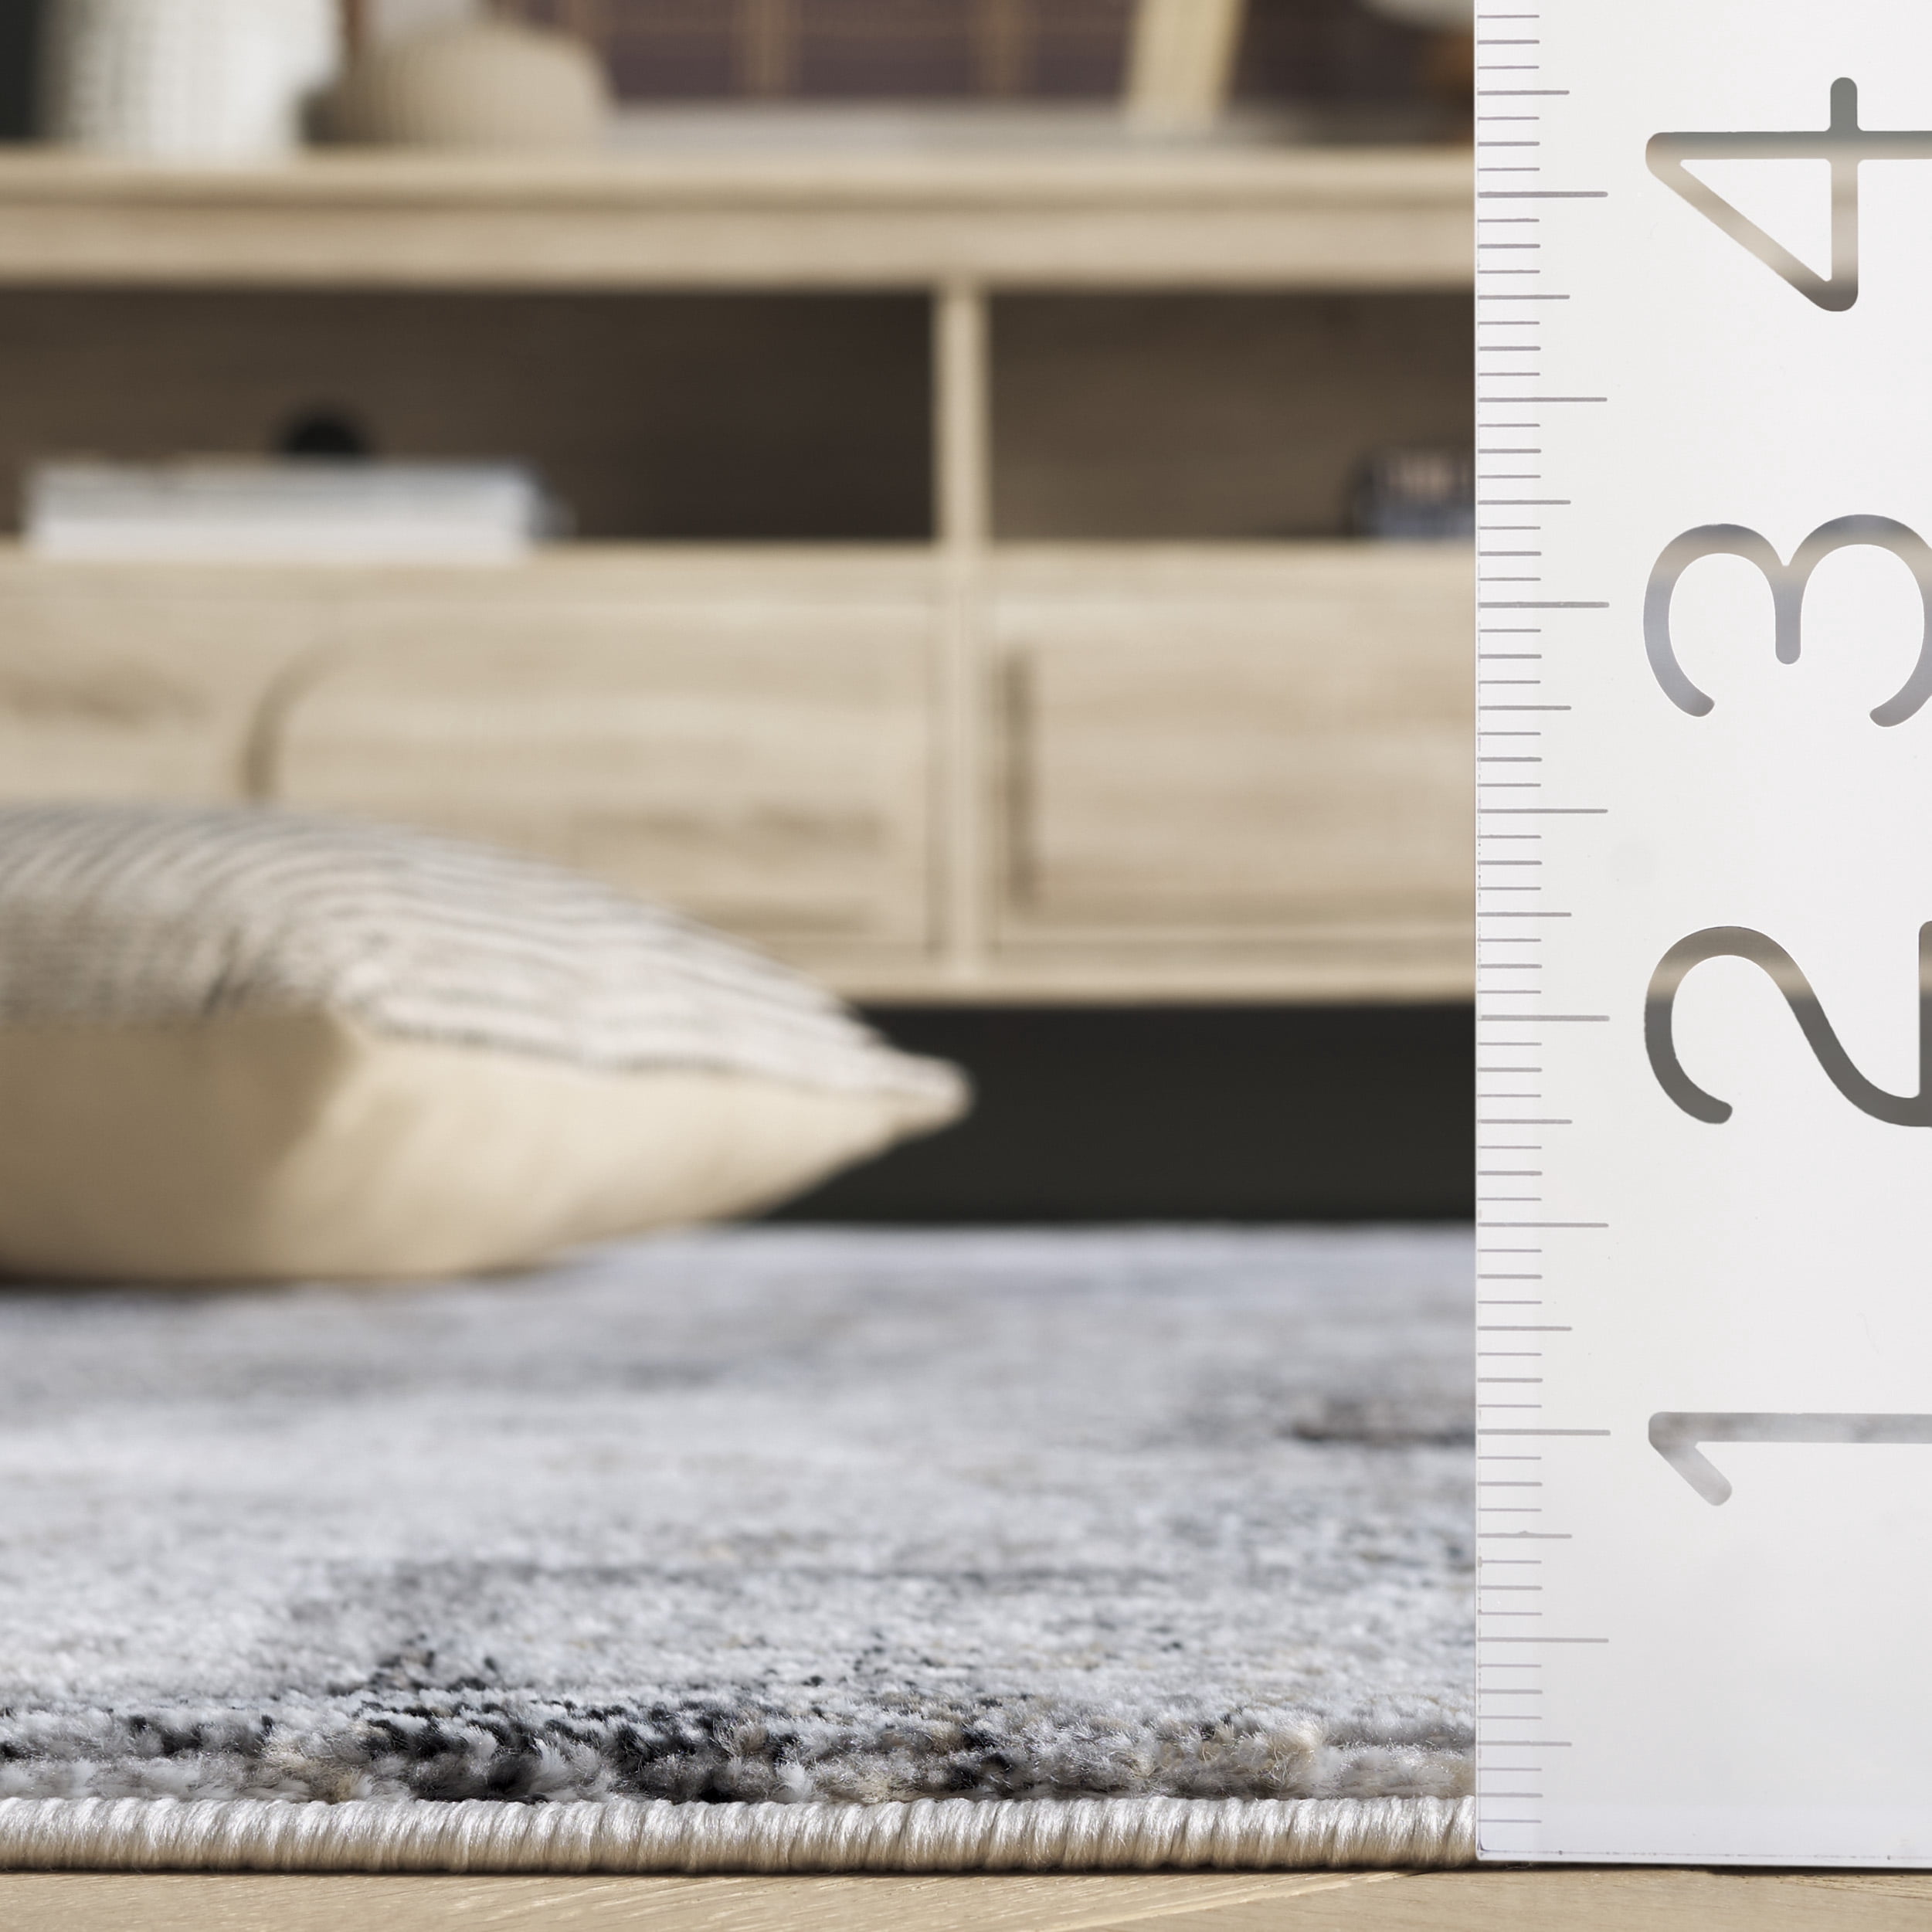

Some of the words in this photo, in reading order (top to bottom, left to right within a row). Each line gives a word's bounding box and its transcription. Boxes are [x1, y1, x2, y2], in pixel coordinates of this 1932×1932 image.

[1645, 77, 1932, 312] 4
[1643, 514, 1932, 728] 3
[1644, 921, 1932, 1127] 2
[1648, 1411, 1932, 1506] 1
